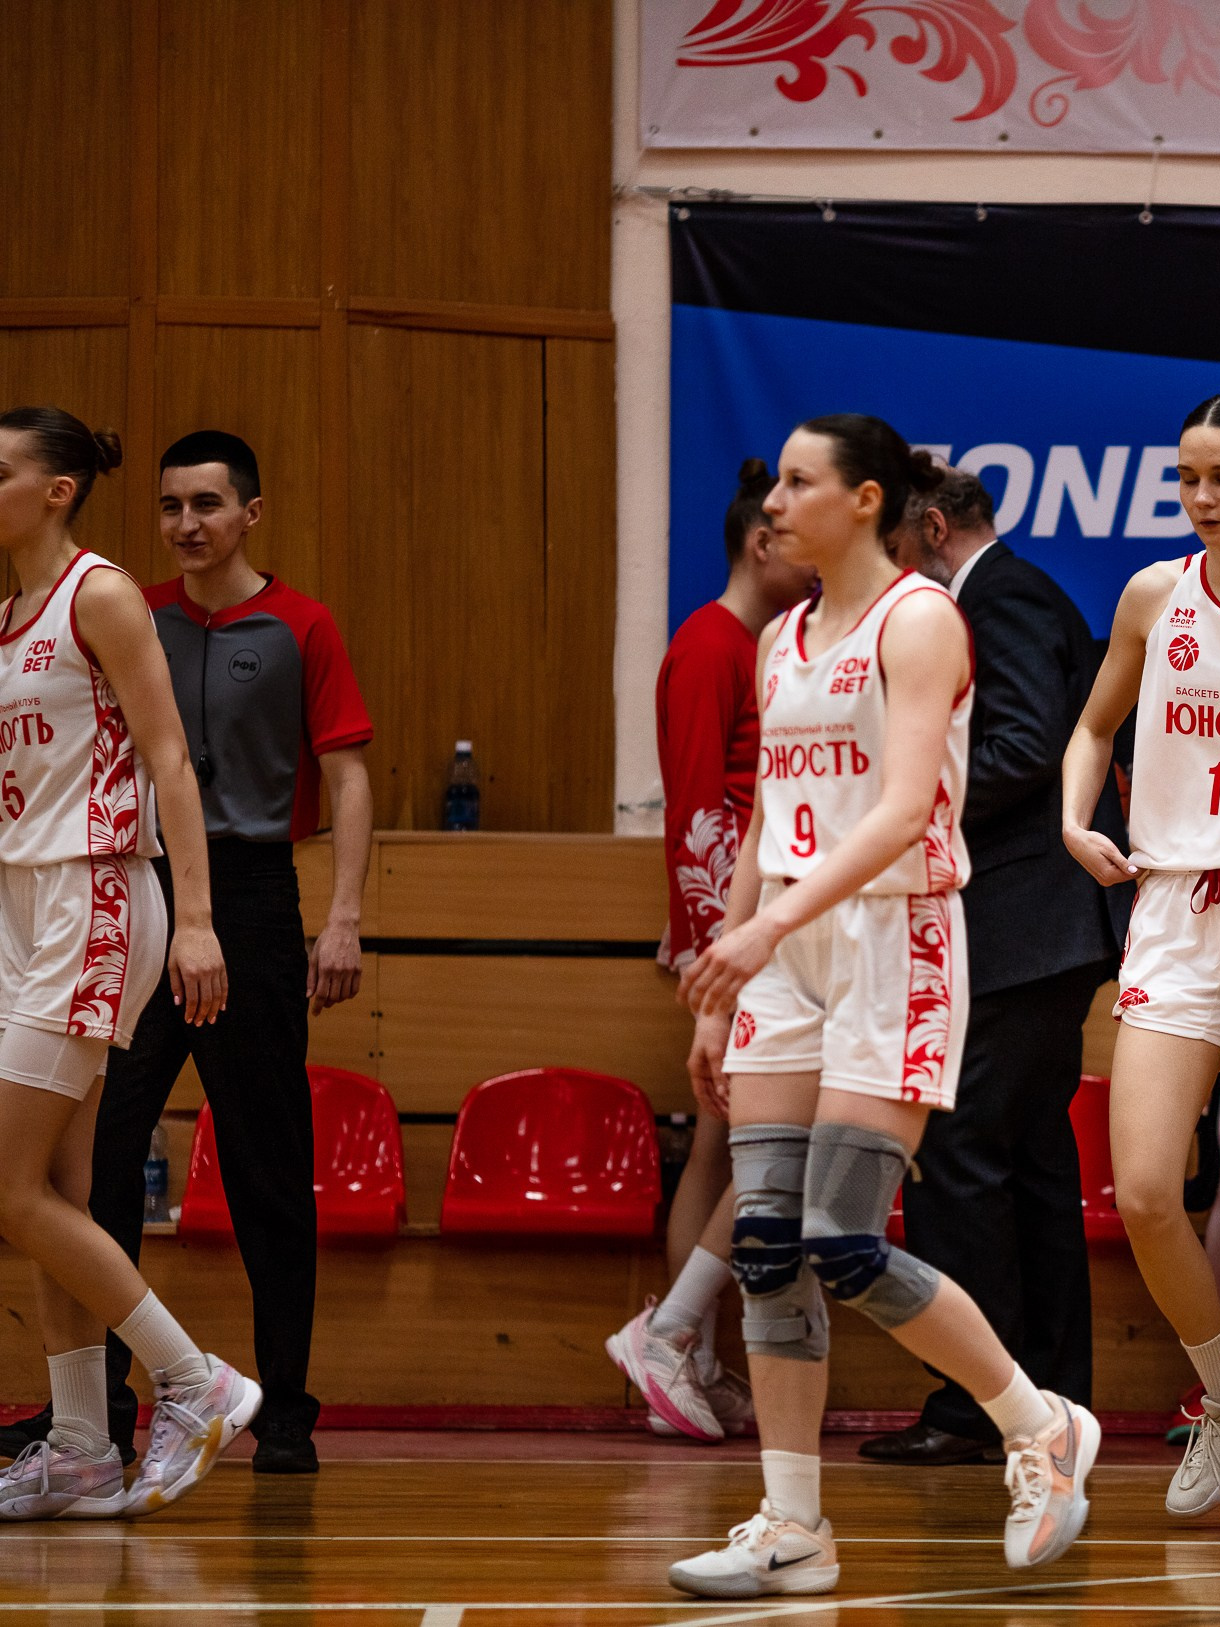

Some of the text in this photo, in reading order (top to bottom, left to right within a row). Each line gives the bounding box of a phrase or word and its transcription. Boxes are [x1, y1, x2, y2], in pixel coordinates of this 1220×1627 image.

[1169, 617, 1197, 626] SPORT
[22, 655, 56, 674] BET
[833, 657, 870, 676] FON
[829, 676, 869, 695] BET
[790, 803, 817, 858] 9
